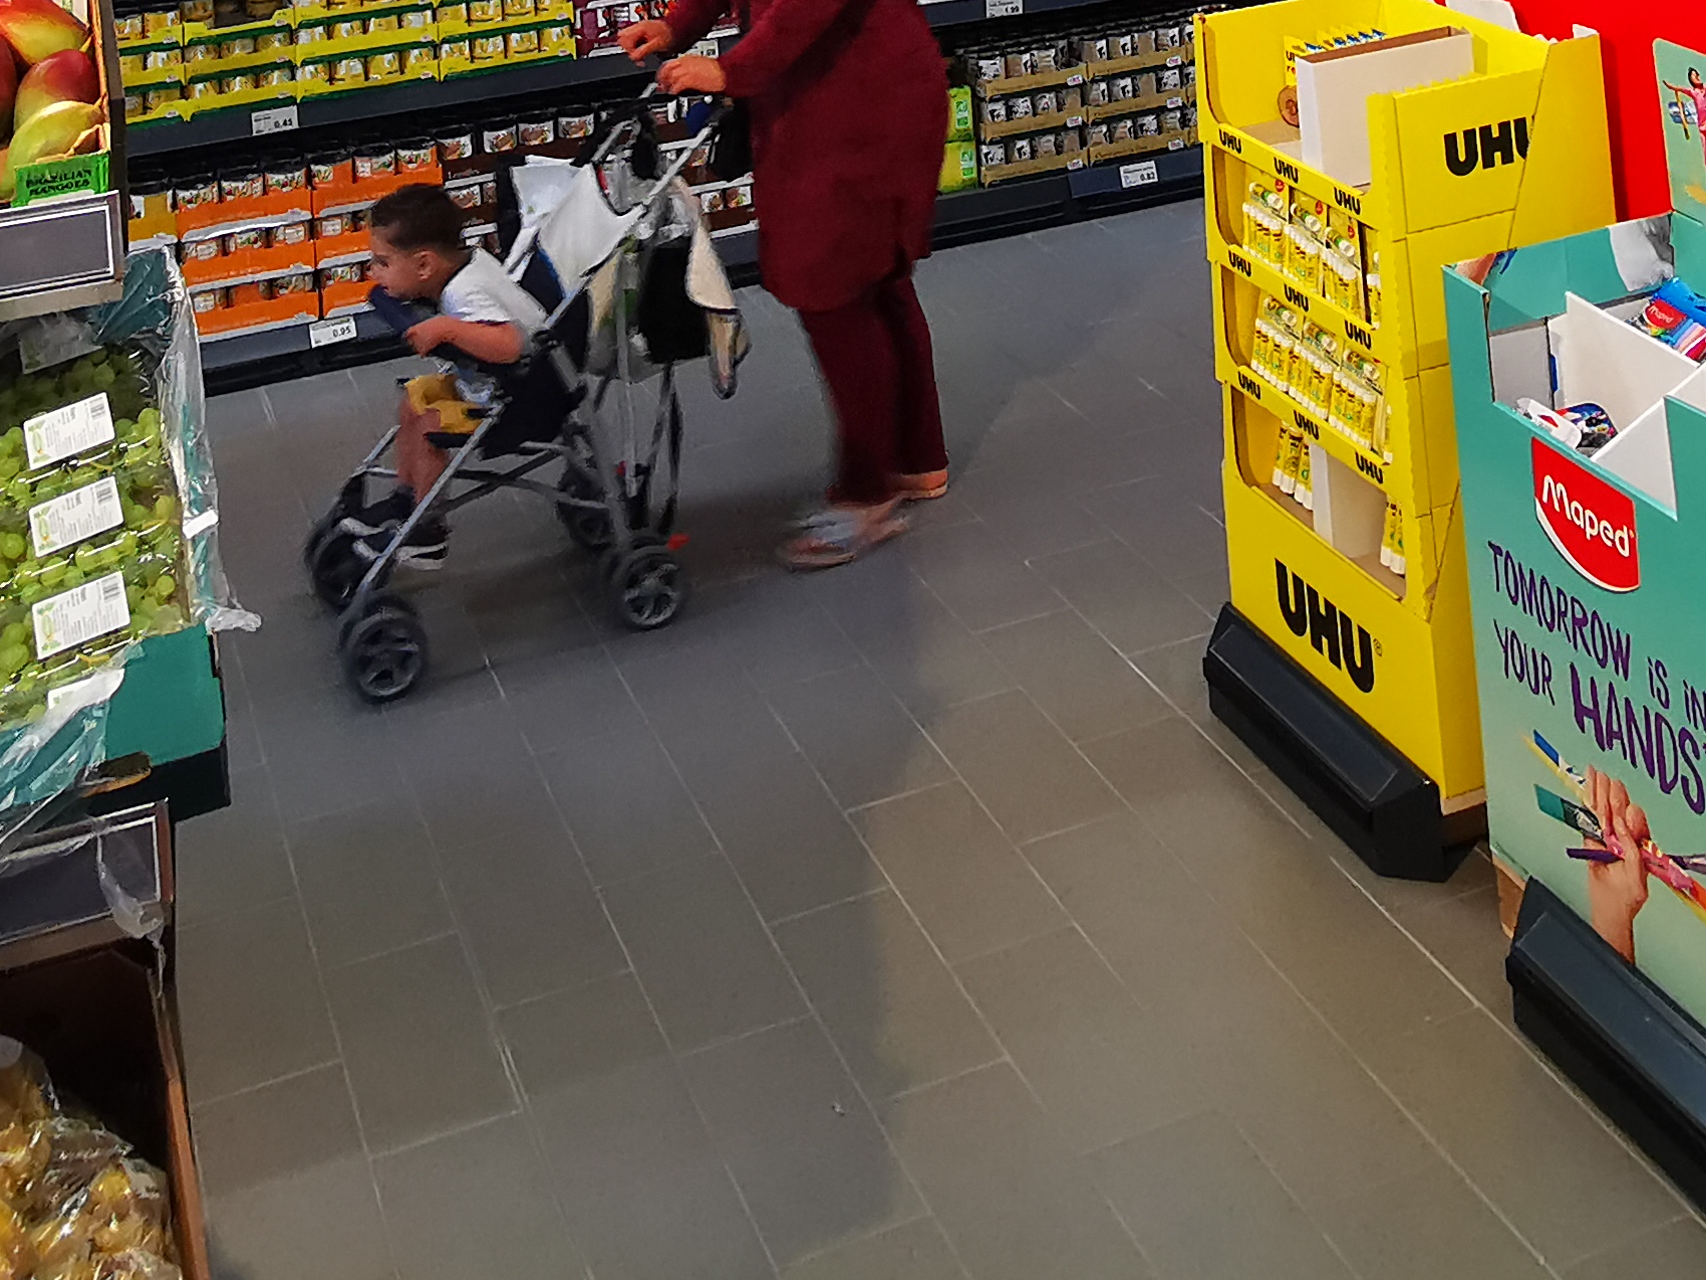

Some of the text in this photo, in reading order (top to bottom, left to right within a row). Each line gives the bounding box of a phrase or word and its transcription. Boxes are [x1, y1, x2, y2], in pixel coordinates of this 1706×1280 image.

[1219, 128, 1242, 155] UHU
[1274, 156, 1299, 184] UHU
[28, 178, 91, 196] MANGOES
[1333, 186, 1361, 216] UHU
[1229, 250, 1252, 277] UHU
[1284, 284, 1309, 313] UHU
[1344, 319, 1372, 350] UHU
[1238, 371, 1261, 400] UHU
[1293, 409, 1320, 441] UHU
[1355, 451, 1383, 484] UHU
[1542, 474, 1631, 558] Maped
[1487, 540, 1632, 681] TOMORROW
[1275, 558, 1375, 694] UHU
[1493, 618, 1556, 706] YOUR
